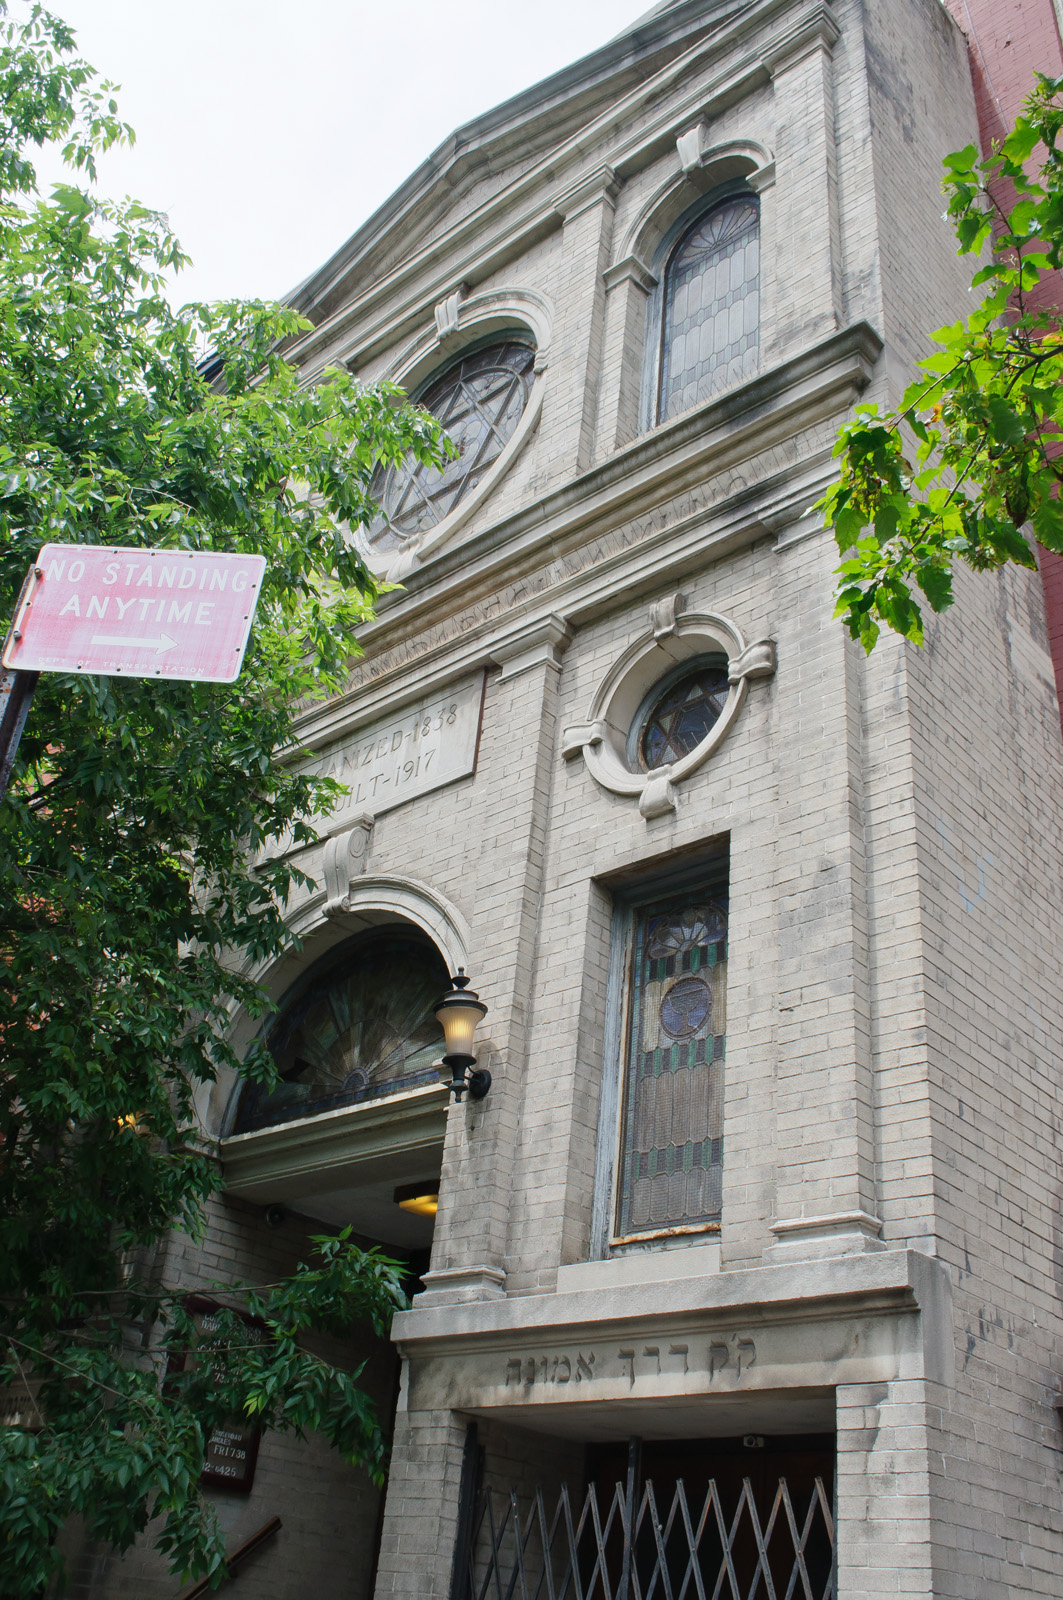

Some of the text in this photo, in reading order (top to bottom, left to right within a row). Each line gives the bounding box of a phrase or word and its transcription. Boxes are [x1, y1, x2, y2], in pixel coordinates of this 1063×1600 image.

[46, 560, 249, 592] NO STANDING
[59, 594, 215, 625] ANYTIME
[77, 659, 91, 667] OF
[103, 661, 205, 674] TRANSPORTATION
[315, 703, 458, 777] ANIZED-1838
[319, 748, 437, 818] UILT-1917
[505, 1351, 596, 1387] אמונה
